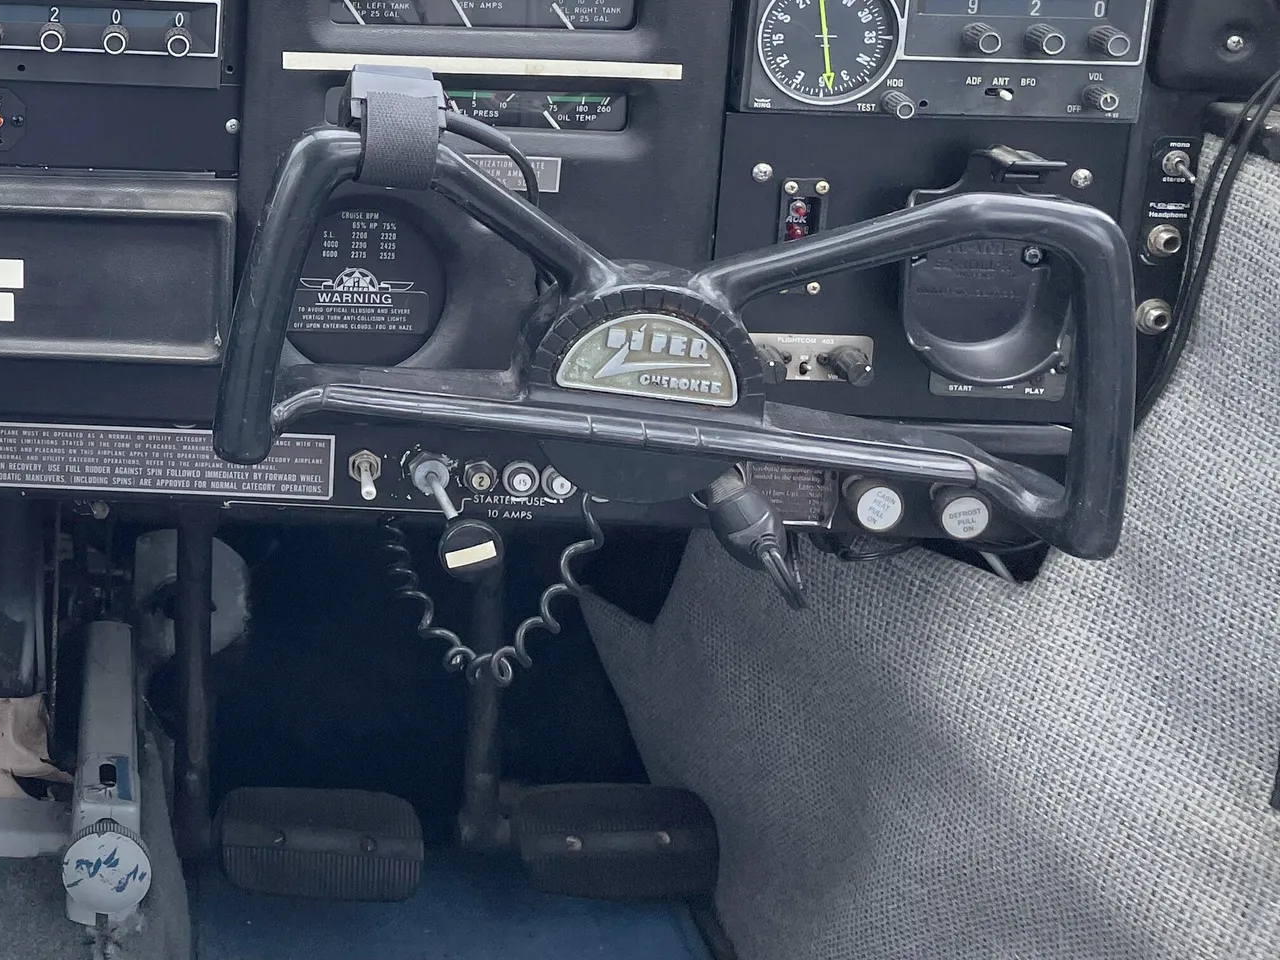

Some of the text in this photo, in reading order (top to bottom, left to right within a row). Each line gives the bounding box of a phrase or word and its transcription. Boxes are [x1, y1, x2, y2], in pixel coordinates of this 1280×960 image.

[1029, 0, 1040, 16] 2
[1094, 0, 1105, 17] 0
[965, 77, 1036, 86] ADF ANT BFO
[1088, 72, 1104, 81] VOL
[886, 79, 904, 87] HDG
[856, 103, 876, 111] TEST
[318, 293, 392, 303] WARNING
[639, 374, 721, 393] CHEROKEE
[1025, 387, 1045, 395] PLAY
[48, 464, 61, 472] USE
[65, 465, 81, 473] FULL
[85, 465, 111, 474] RUDDER
[114, 466, 143, 475] AGAINST
[205, 470, 249, 479] IMMEDIATELY
[264, 473, 297, 482] FORWARD
[156, 479, 190, 488] APPROVED
[242, 482, 276, 491] CATEGORY
[487, 509, 532, 519] 10 AMPS
[948, 507, 981, 520] DEFROST
